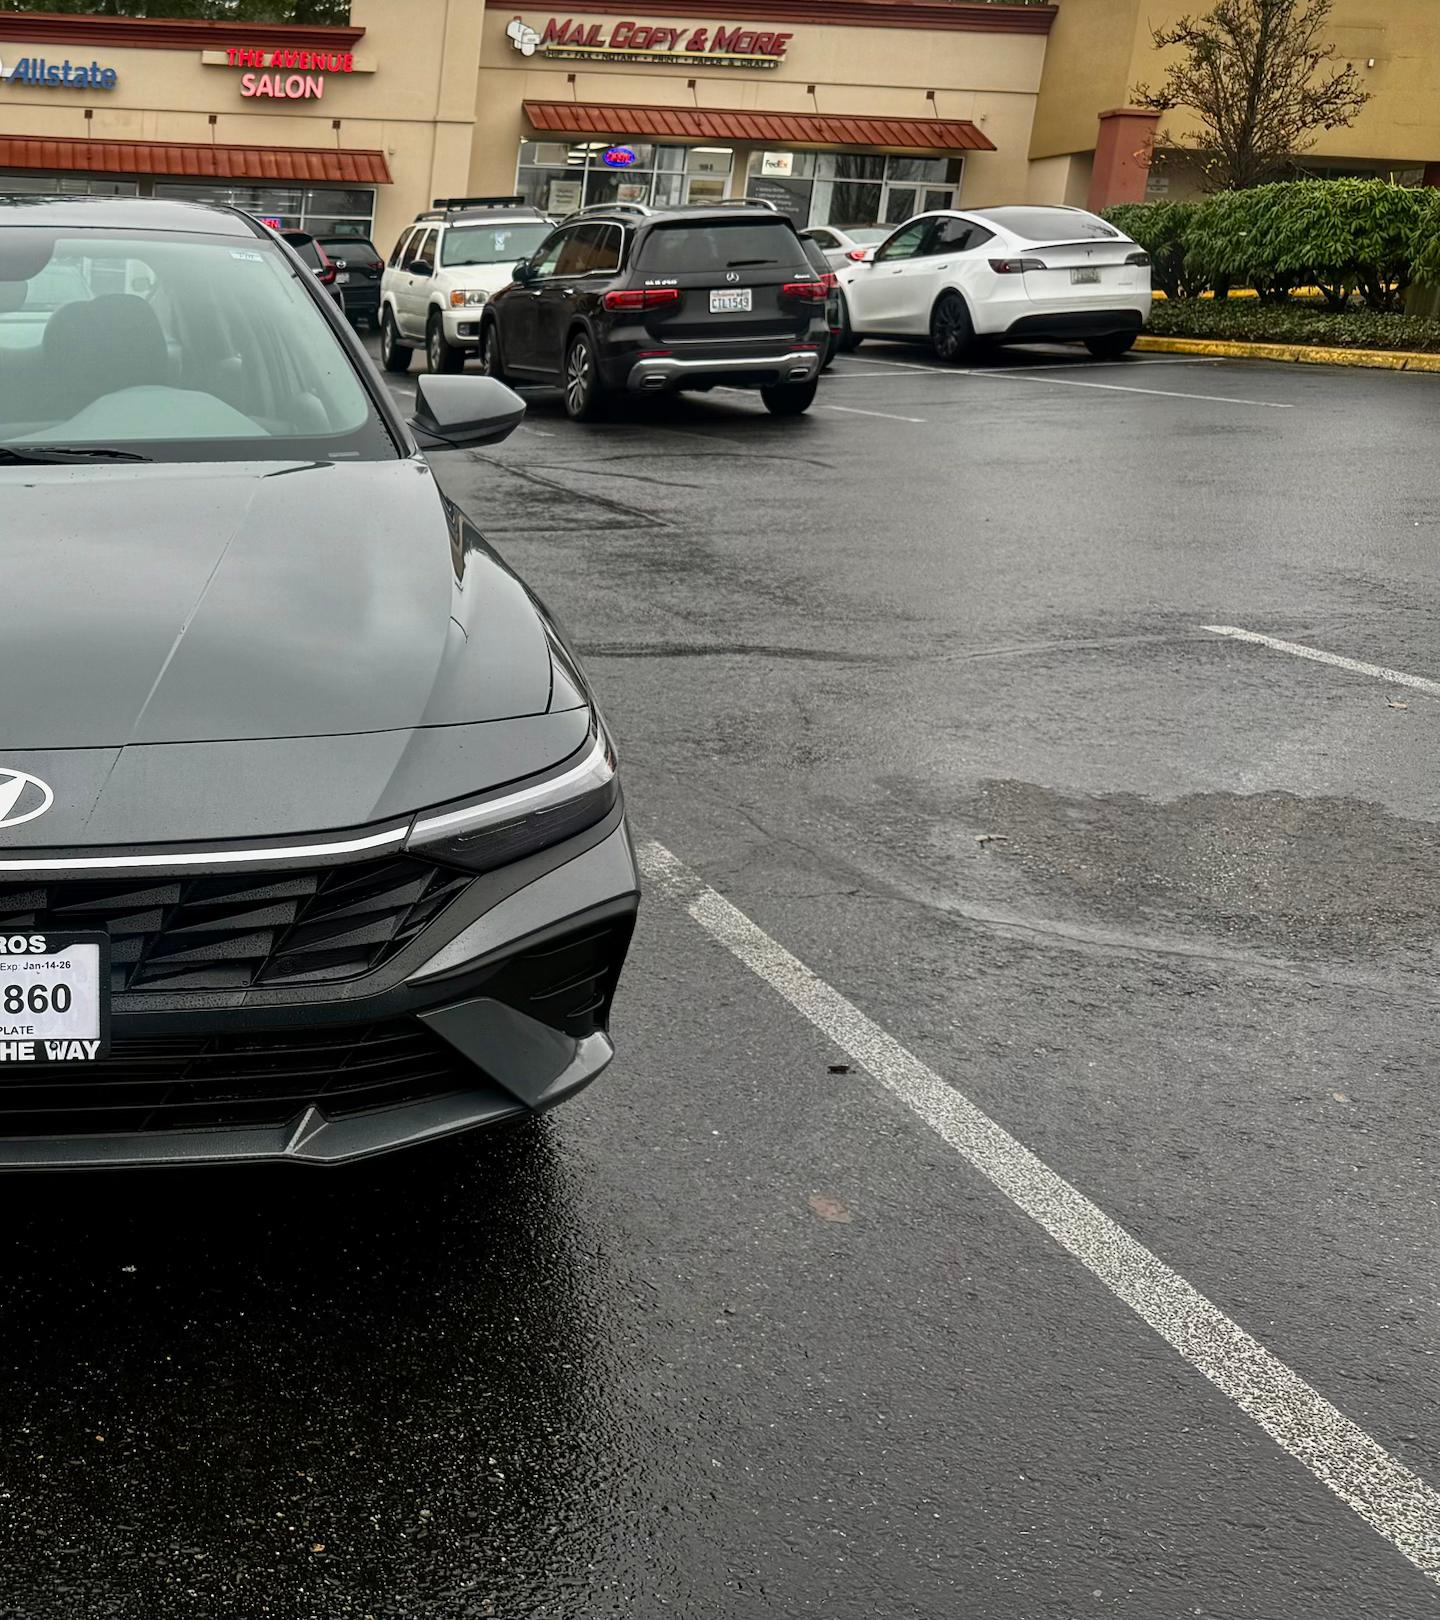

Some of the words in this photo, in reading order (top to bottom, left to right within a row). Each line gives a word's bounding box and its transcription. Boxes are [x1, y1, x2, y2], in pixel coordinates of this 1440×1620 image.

[542, 18, 606, 47] MAIL
[609, 21, 689, 50] COPY
[685, 28, 709, 51] &
[706, 26, 794, 55] MORE
[227, 48, 265, 67] THE
[270, 50, 353, 72] AVENUE
[576, 52, 594, 60] FAX
[602, 53, 640, 61] NOTARY
[652, 55, 680, 63] PRINT
[692, 57, 723, 65] PAPER
[8, 58, 117, 89] Allstate
[240, 73, 324, 99] SALON
[23, 961, 71, 970] Jan-14-26
[44, 1039, 101, 1061] WAY
